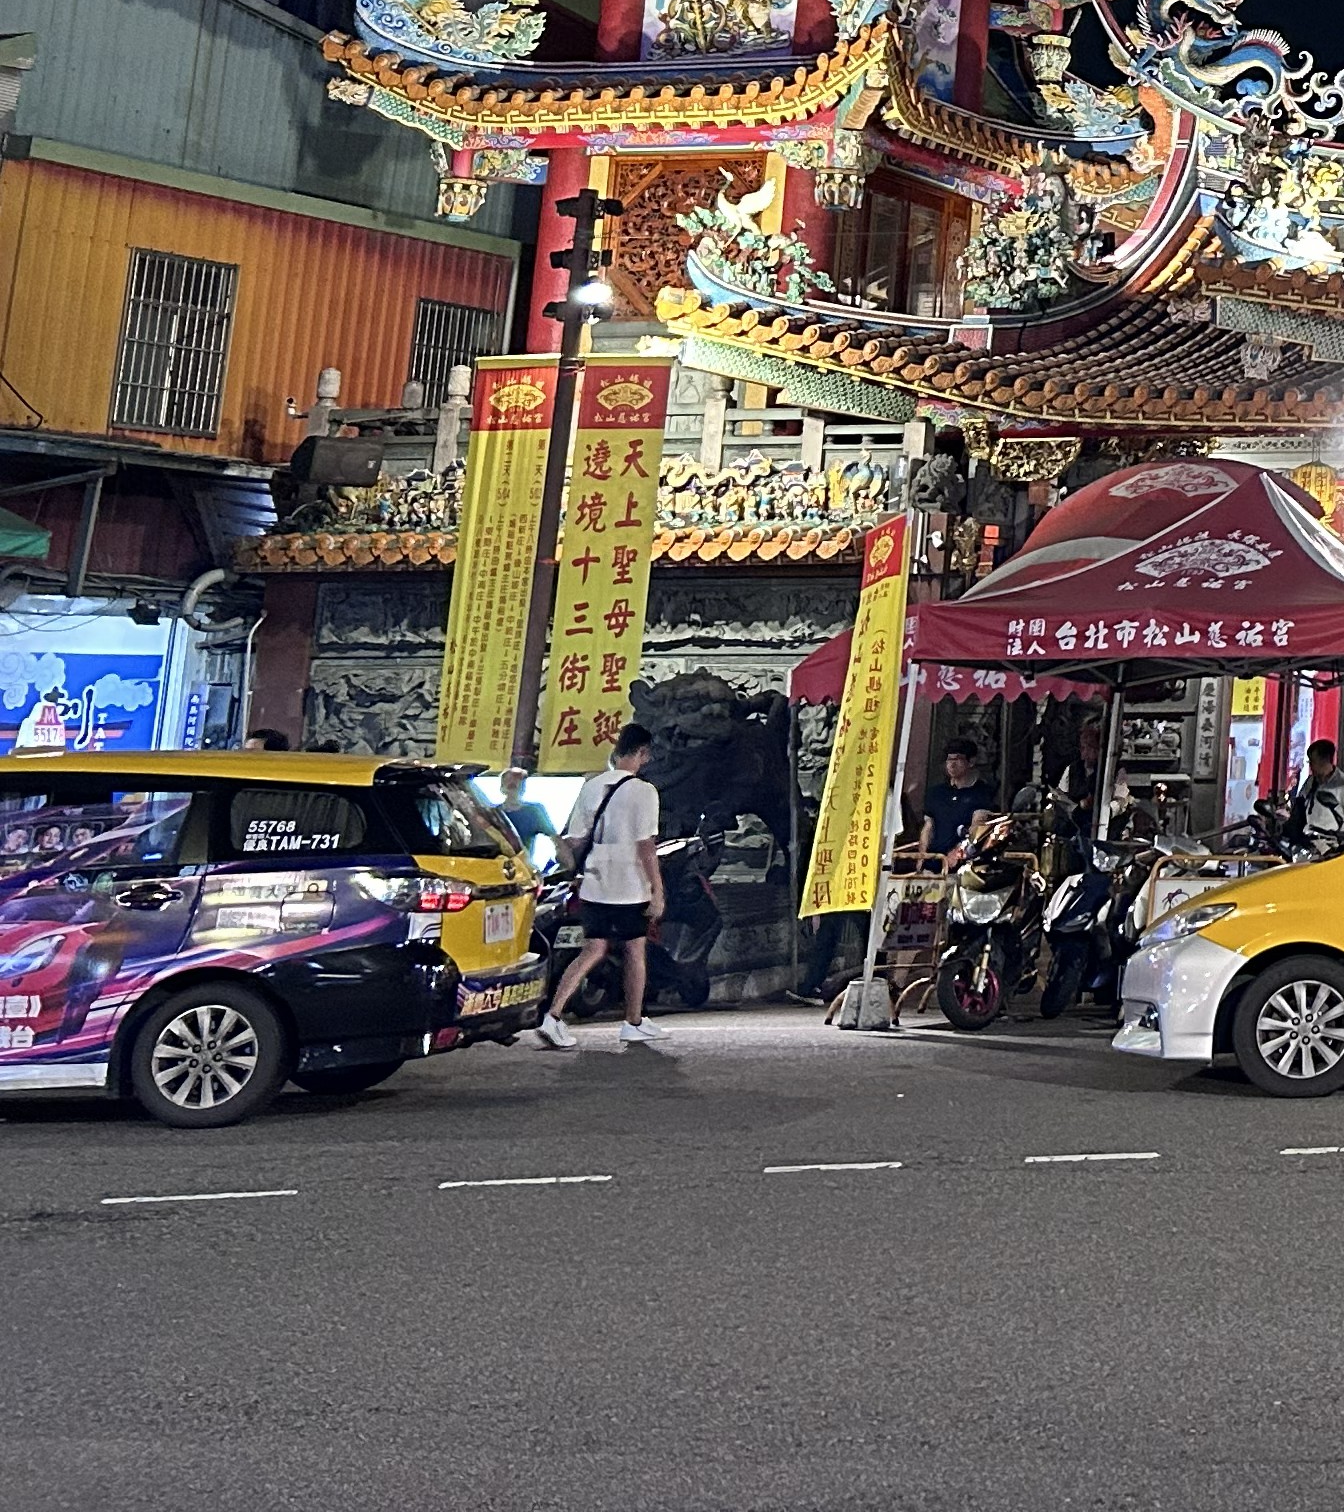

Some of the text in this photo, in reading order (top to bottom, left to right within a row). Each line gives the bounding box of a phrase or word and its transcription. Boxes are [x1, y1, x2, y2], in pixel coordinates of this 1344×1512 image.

[552, 439, 612, 747] 遶境十三街庄
[1055, 618, 1295, 650] 台北市松山慈祐宮
[1006, 638, 1047, 656] 法人
[248, 820, 296, 833] 55768
